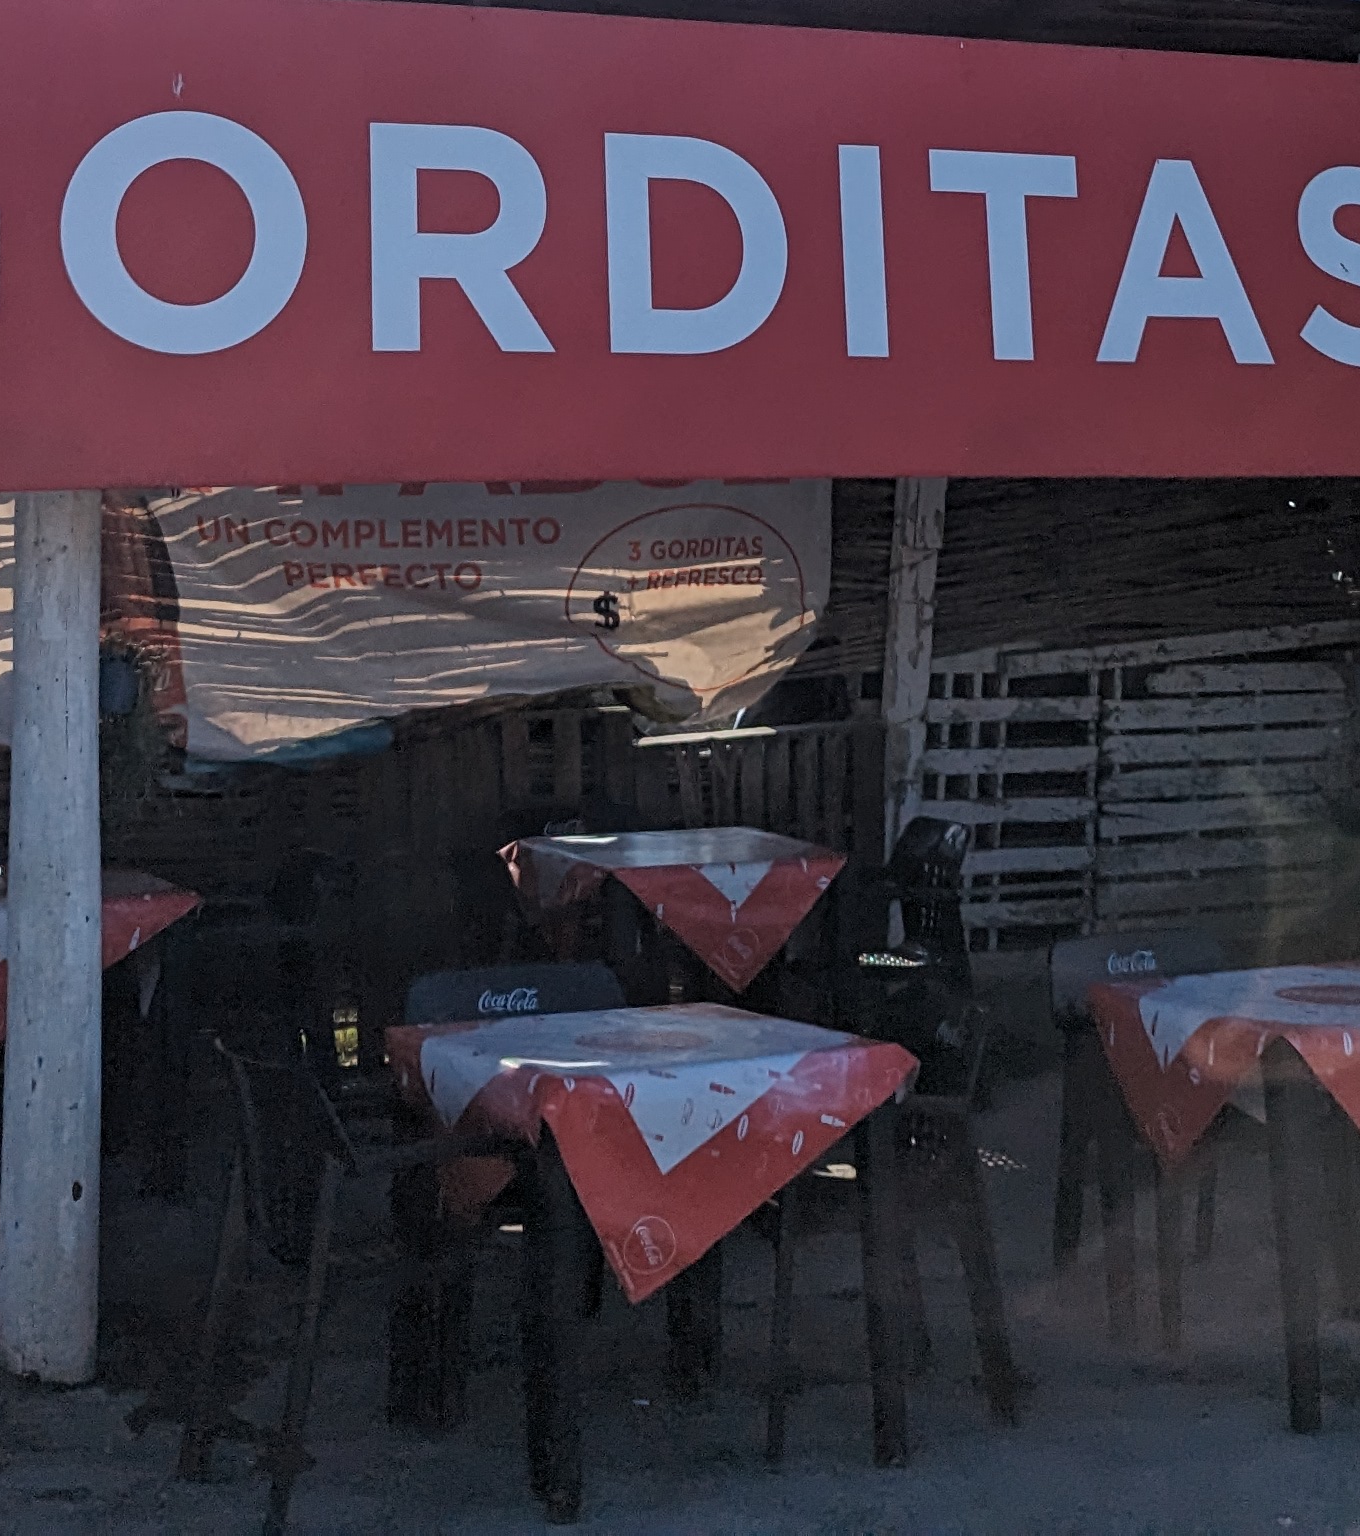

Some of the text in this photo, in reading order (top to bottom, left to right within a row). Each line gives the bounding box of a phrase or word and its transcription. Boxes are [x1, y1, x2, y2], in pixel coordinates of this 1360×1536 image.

[197, 514, 561, 549] UN COMPLEMENTO
[627, 536, 764, 561] 3 GORDITAS
[282, 560, 483, 590] PERFECTO
[646, 565, 764, 590] REFRESCO
[593, 590, 621, 631] $
